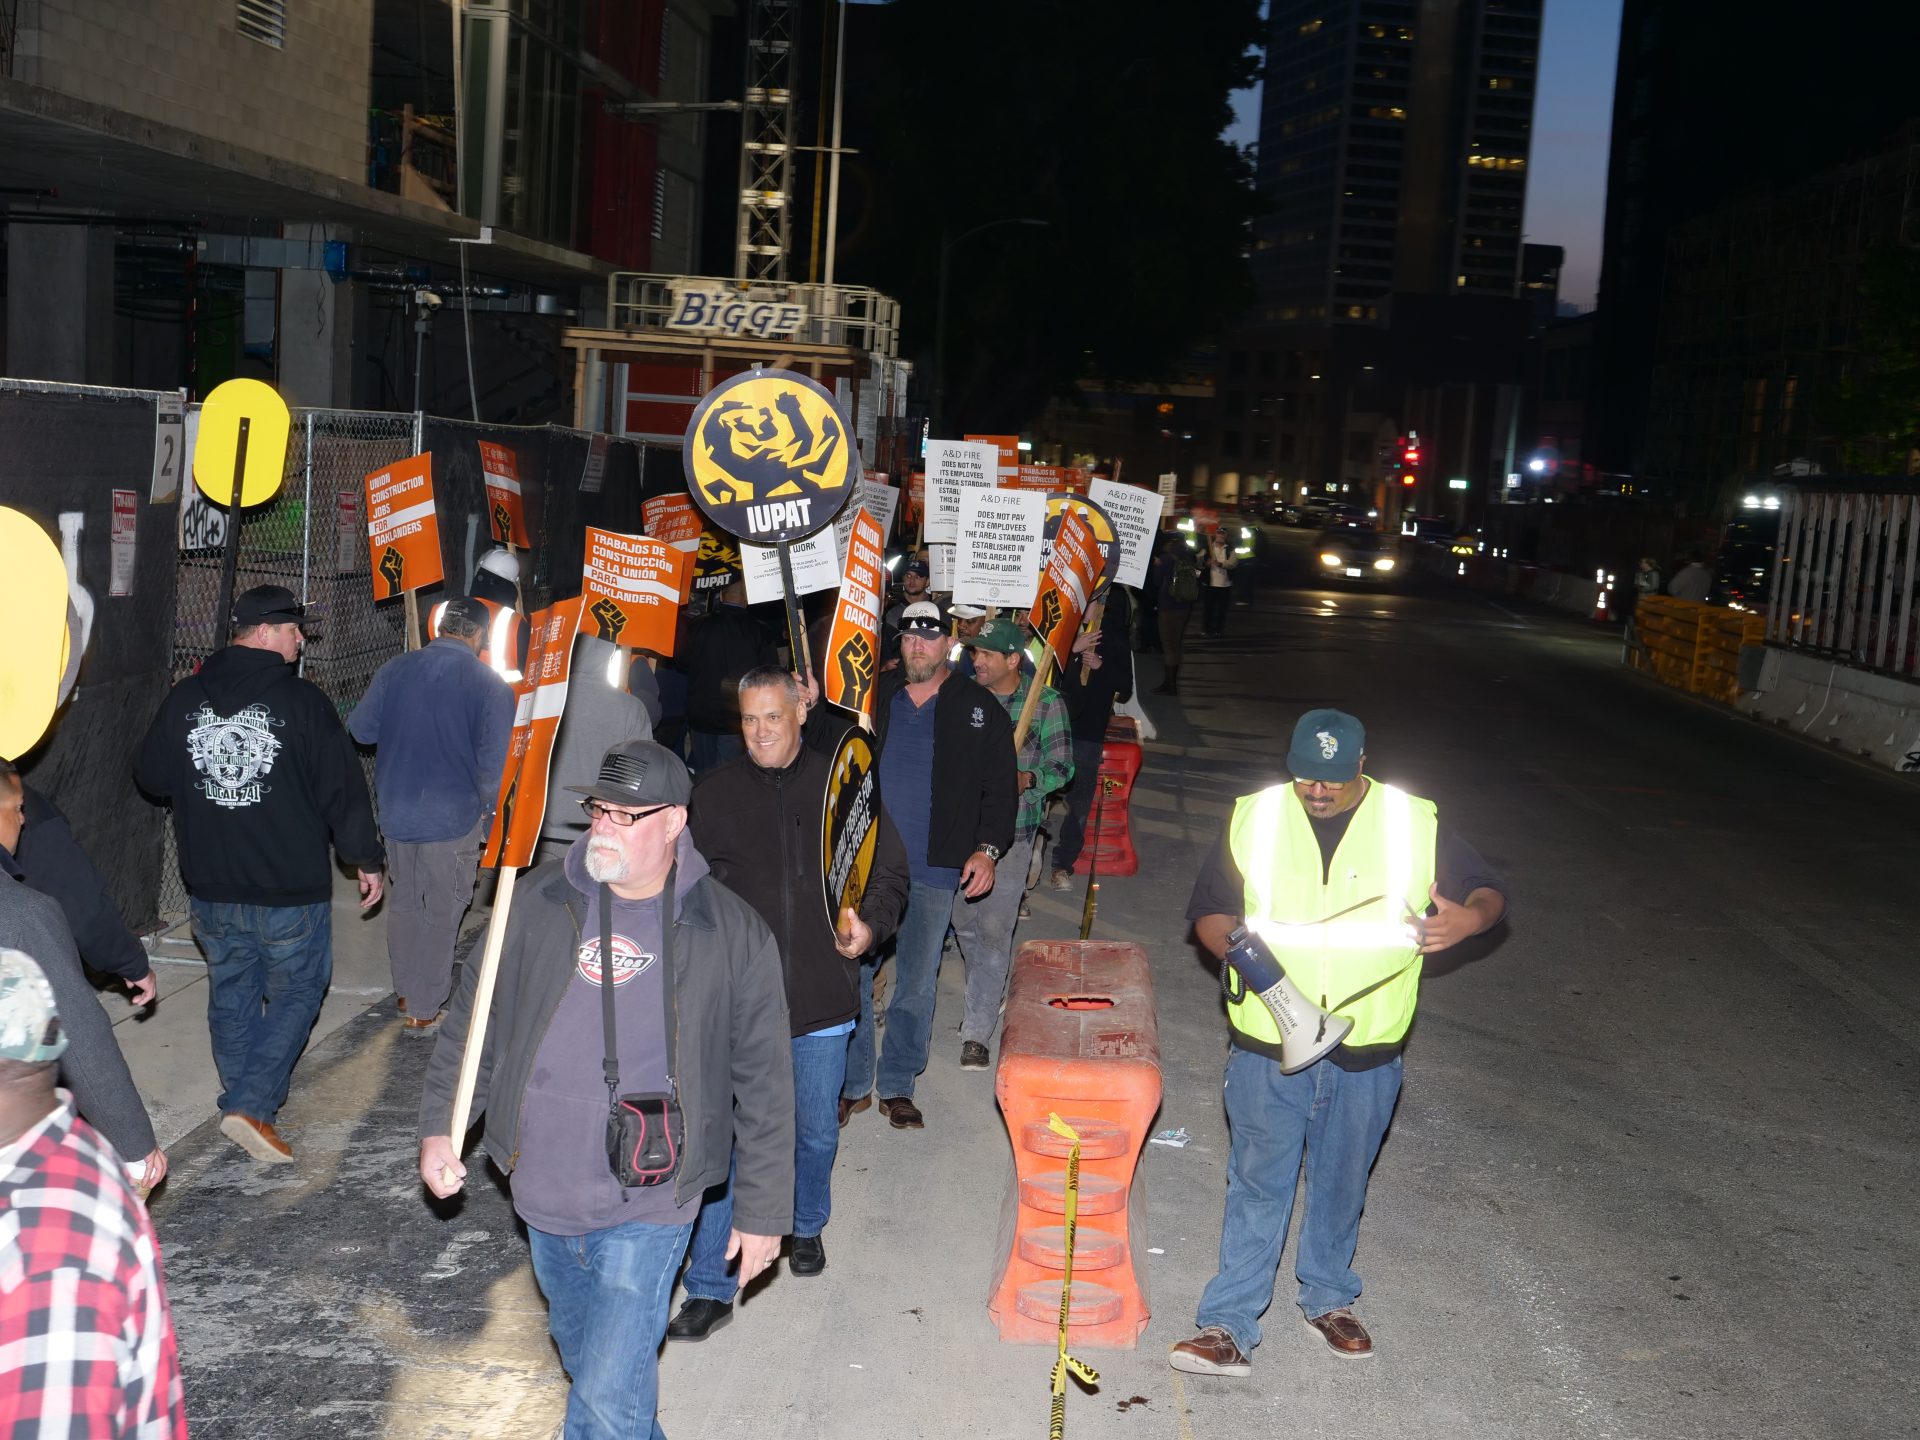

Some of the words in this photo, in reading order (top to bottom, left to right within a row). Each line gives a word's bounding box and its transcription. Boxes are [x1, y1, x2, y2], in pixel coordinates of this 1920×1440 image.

[161, 435, 174, 476] 2
[943, 449, 962, 459] A&D
[964, 451, 981, 460] FIRE
[958, 461, 969, 469] NOT
[370, 472, 391, 491] UNION
[950, 470, 984, 479] EMPLOYEES
[371, 475, 425, 505] CONSTRUCTION
[1108, 490, 1127, 500] A&D
[1129, 494, 1148, 505] FIRE
[646, 500, 666, 509] UNION
[939, 495, 953, 503] THIS
[981, 494, 1001, 504] A&D
[1003, 496, 1021, 505] FIRE
[373, 503, 391, 519] JOBS
[647, 504, 692, 517] CONSTRUCTIO
[939, 504, 960, 512] SIMILA
[1104, 500, 1118, 509] DOES
[1120, 504, 1132, 512] NOT
[1132, 507, 1145, 515] PAY
[746, 498, 811, 534] IUPAT
[977, 510, 995, 520] DOES
[996, 512, 1010, 521] NOT
[1011, 513, 1025, 522] PAY
[1110, 511, 1145, 525] EMPLOYEES
[374, 520, 388, 534] FOR
[375, 520, 423, 547] OAKLANDERS
[857, 518, 880, 549] UNION
[974, 520, 985, 529] ITS
[986, 521, 1027, 532] EMPLOYEES
[1066, 515, 1086, 543] UNION
[1119, 522, 1150, 535] STANDARD
[965, 530, 977, 538] THE
[978, 531, 997, 540] AREA
[998, 533, 1035, 543] STANDARD
[593, 532, 649, 554] TRABAJOS
[651, 545, 666, 558] DE
[793, 541, 817, 555] WORK
[972, 541, 1016, 552] ESTABLISHED
[1017, 544, 1025, 552] IN
[592, 545, 673, 573] CONSTRUCCIÓN
[972, 551, 988, 560] THIS
[988, 552, 1007, 561] AREA
[1008, 554, 1021, 562] FOR
[1057, 542, 1073, 566] JOBS
[1062, 528, 1095, 583] CONSTRUCTION
[592, 557, 605, 571] DE
[607, 560, 620, 575] LA
[622, 563, 658, 580] UNIÓN
[971, 561, 1000, 571] SIMILAR
[1001, 563, 1022, 573] WORK
[1054, 554, 1065, 573] FOR
[591, 569, 618, 586] PARA
[696, 573, 732, 589] IUPAT
[851, 563, 873, 588] JOBS
[590, 582, 660, 606] OAKLANDERS
[848, 585, 866, 606] FOR
[215, 755, 229, 765] ONE
[230, 755, 249, 767] UNION
[206, 781, 239, 802] LOCAL
[240, 784, 261, 802] 741
[828, 858, 838, 895] THE
[834, 826, 847, 874] IUPAT
[845, 790, 863, 842] FIGHTS
[862, 769, 874, 805] FOR
[835, 842, 853, 907] WORKING
[851, 803, 872, 857] PEOPLE
[1275, 985, 1290, 1005] DC16
[1263, 993, 1292, 1036] Department
[1269, 989, 1298, 1029] Organizing
